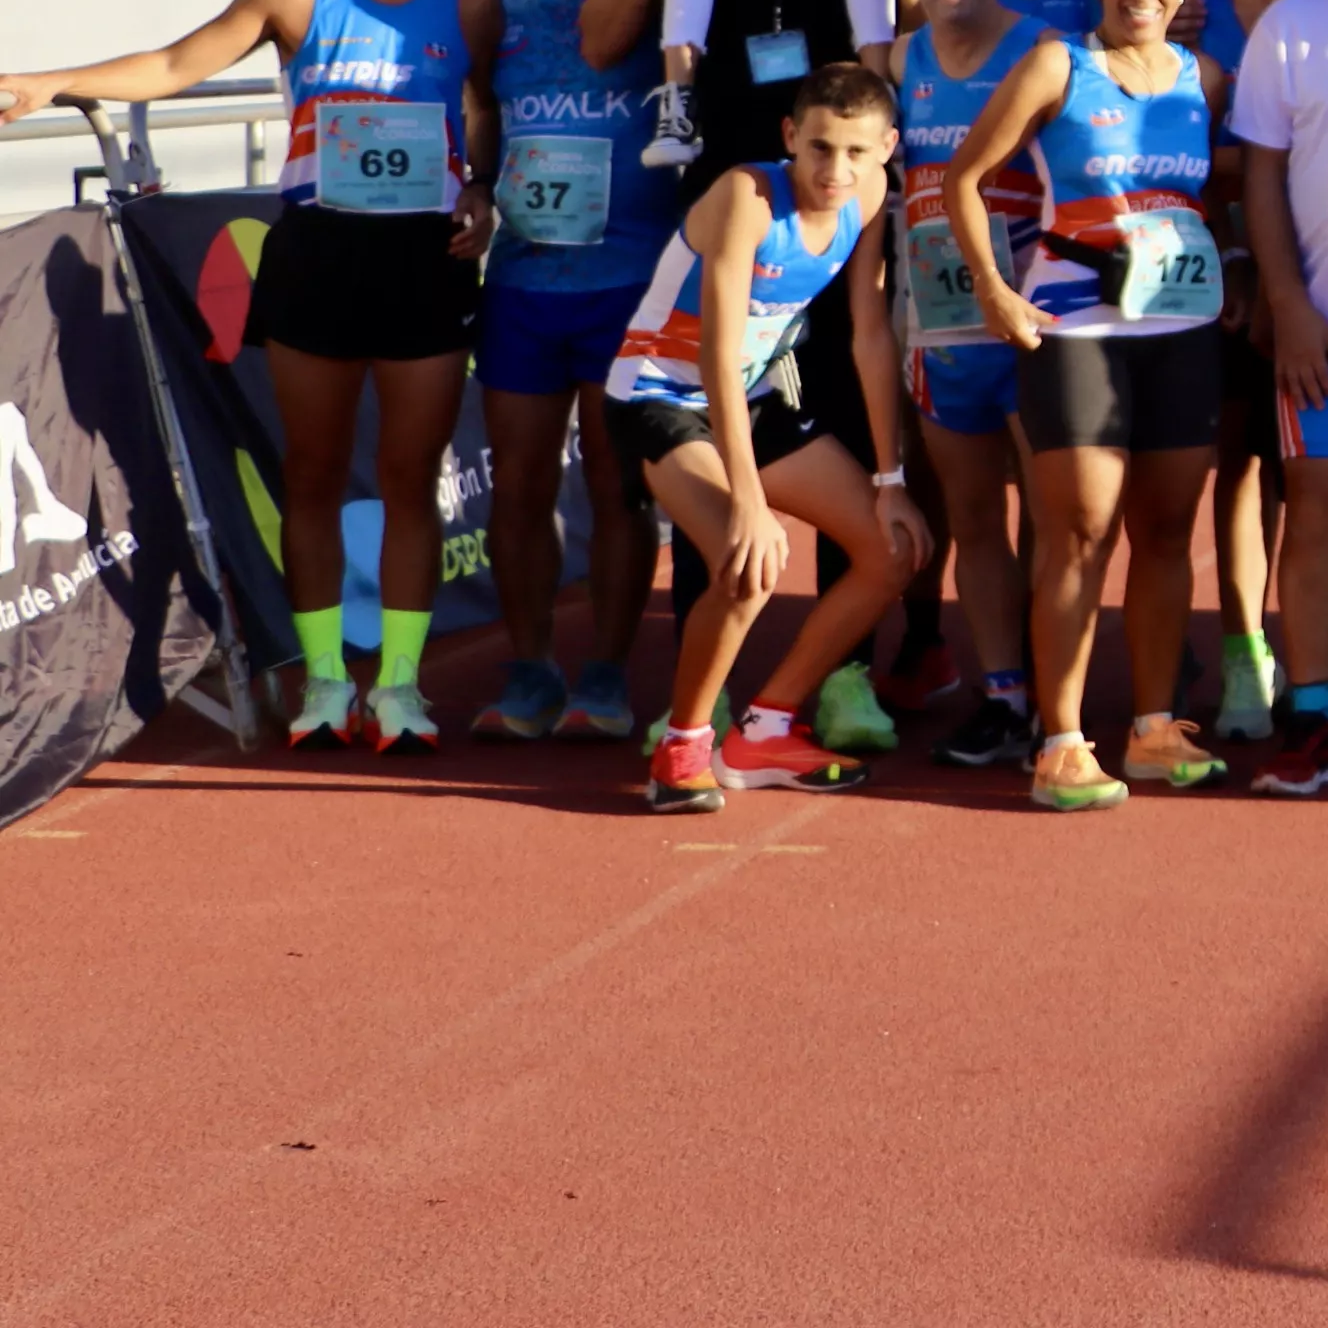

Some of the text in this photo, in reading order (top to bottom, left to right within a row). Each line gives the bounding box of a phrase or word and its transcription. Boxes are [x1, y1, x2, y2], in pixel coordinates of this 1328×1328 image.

[360, 148, 410, 178] 69
[1084, 152, 1210, 181] enerplus
[526, 181, 571, 210] 37
[1156, 254, 1207, 285] 172
